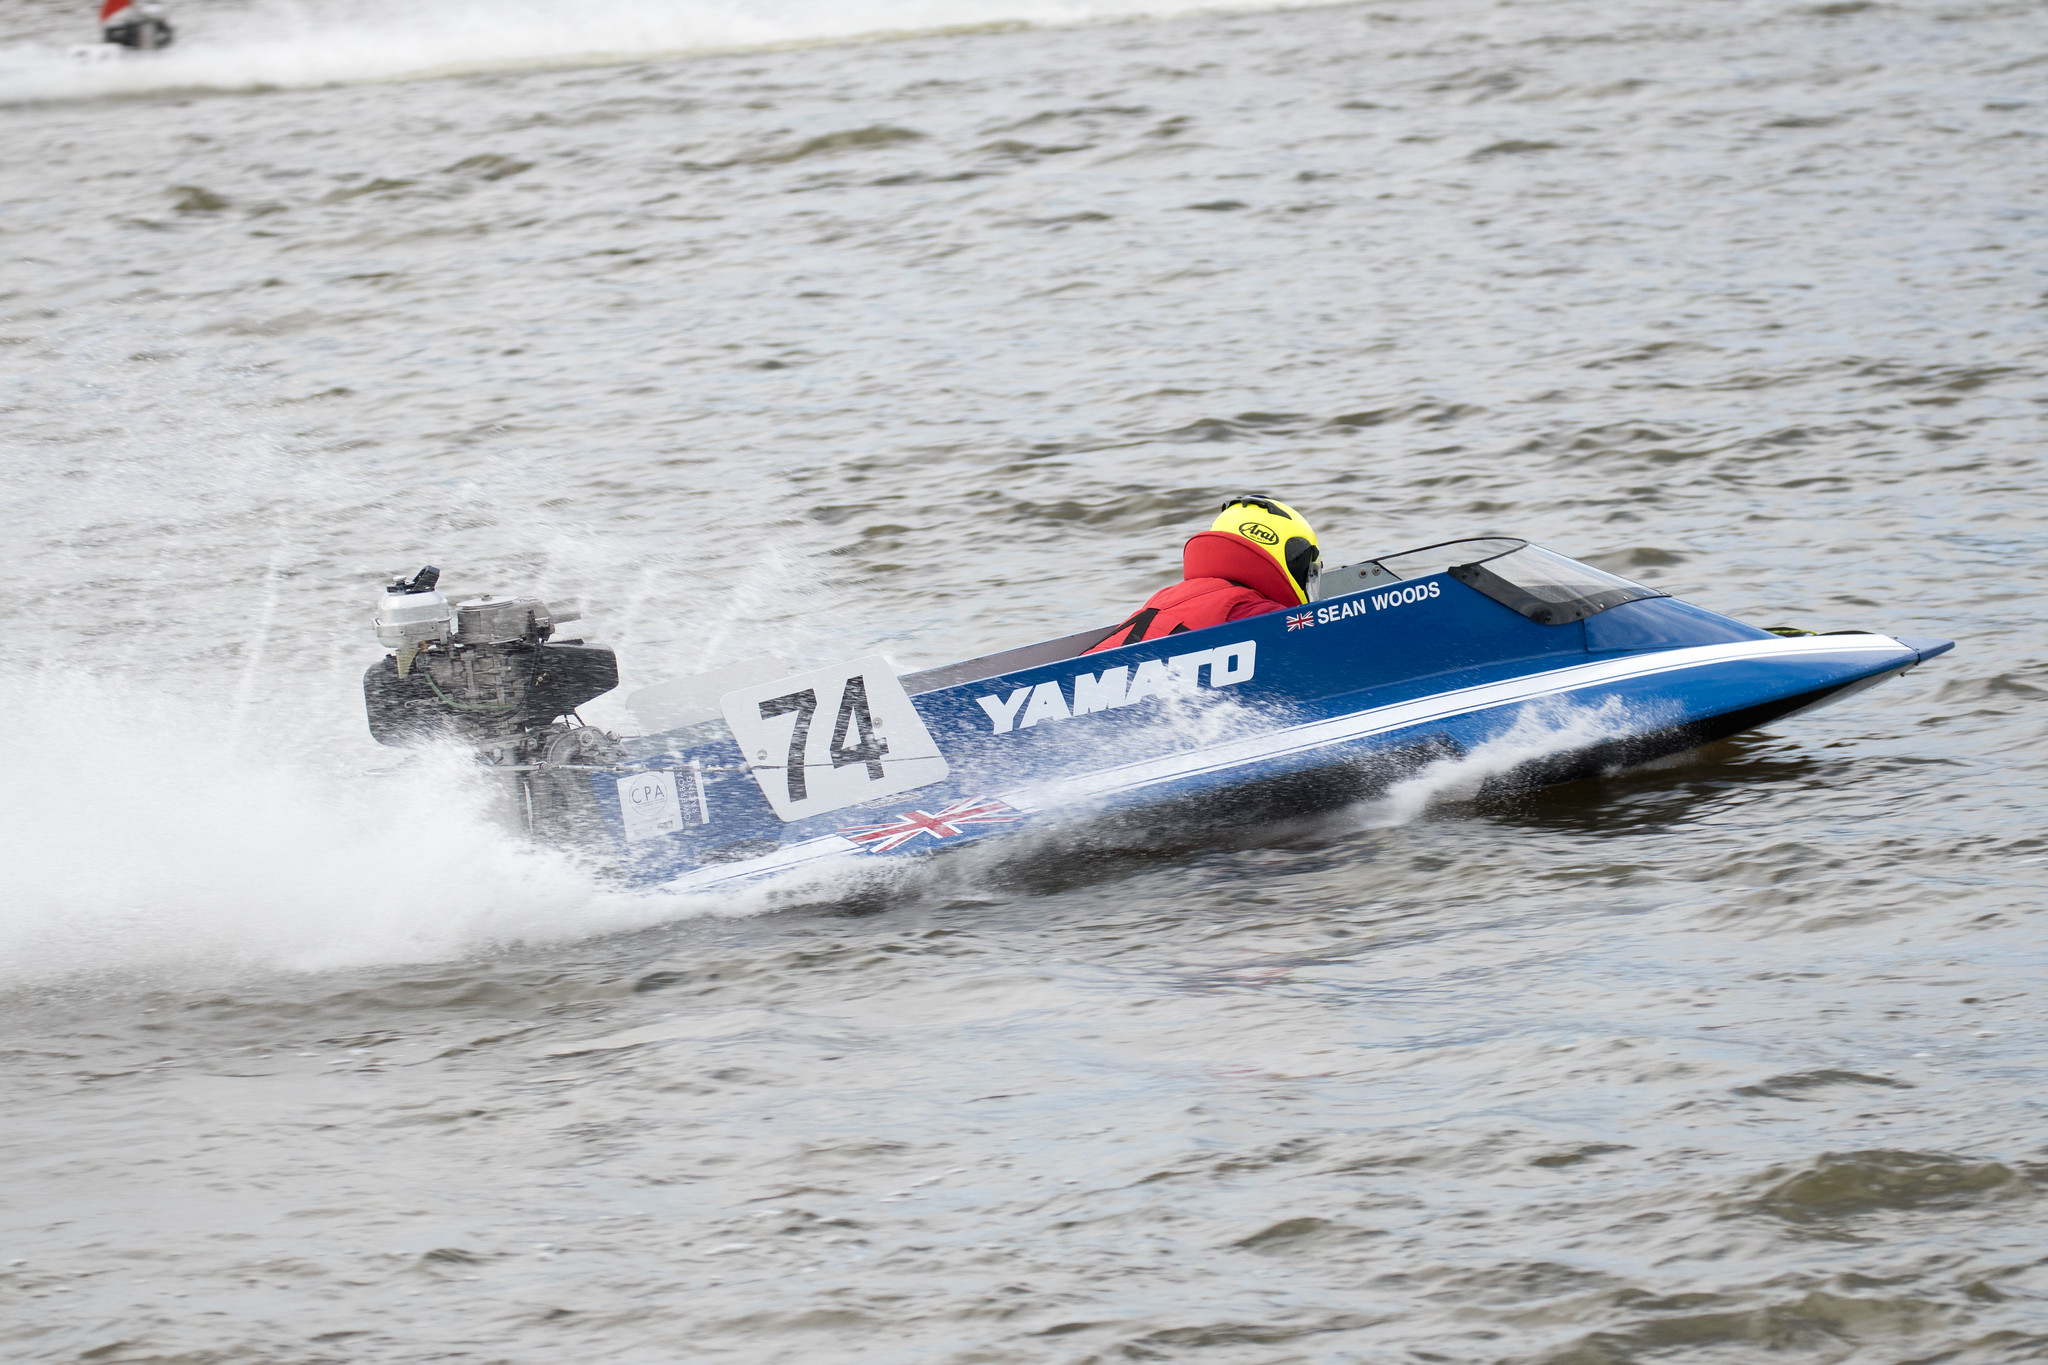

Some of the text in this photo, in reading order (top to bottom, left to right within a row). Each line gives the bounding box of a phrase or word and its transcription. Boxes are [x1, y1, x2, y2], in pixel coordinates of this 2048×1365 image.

[1241, 524, 1275, 541] Arai
[1317, 581, 1441, 624] SEAN WOODS
[975, 639, 1256, 735] YAMATO
[758, 674, 889, 803] 74
[631, 784, 665, 804] CPA
